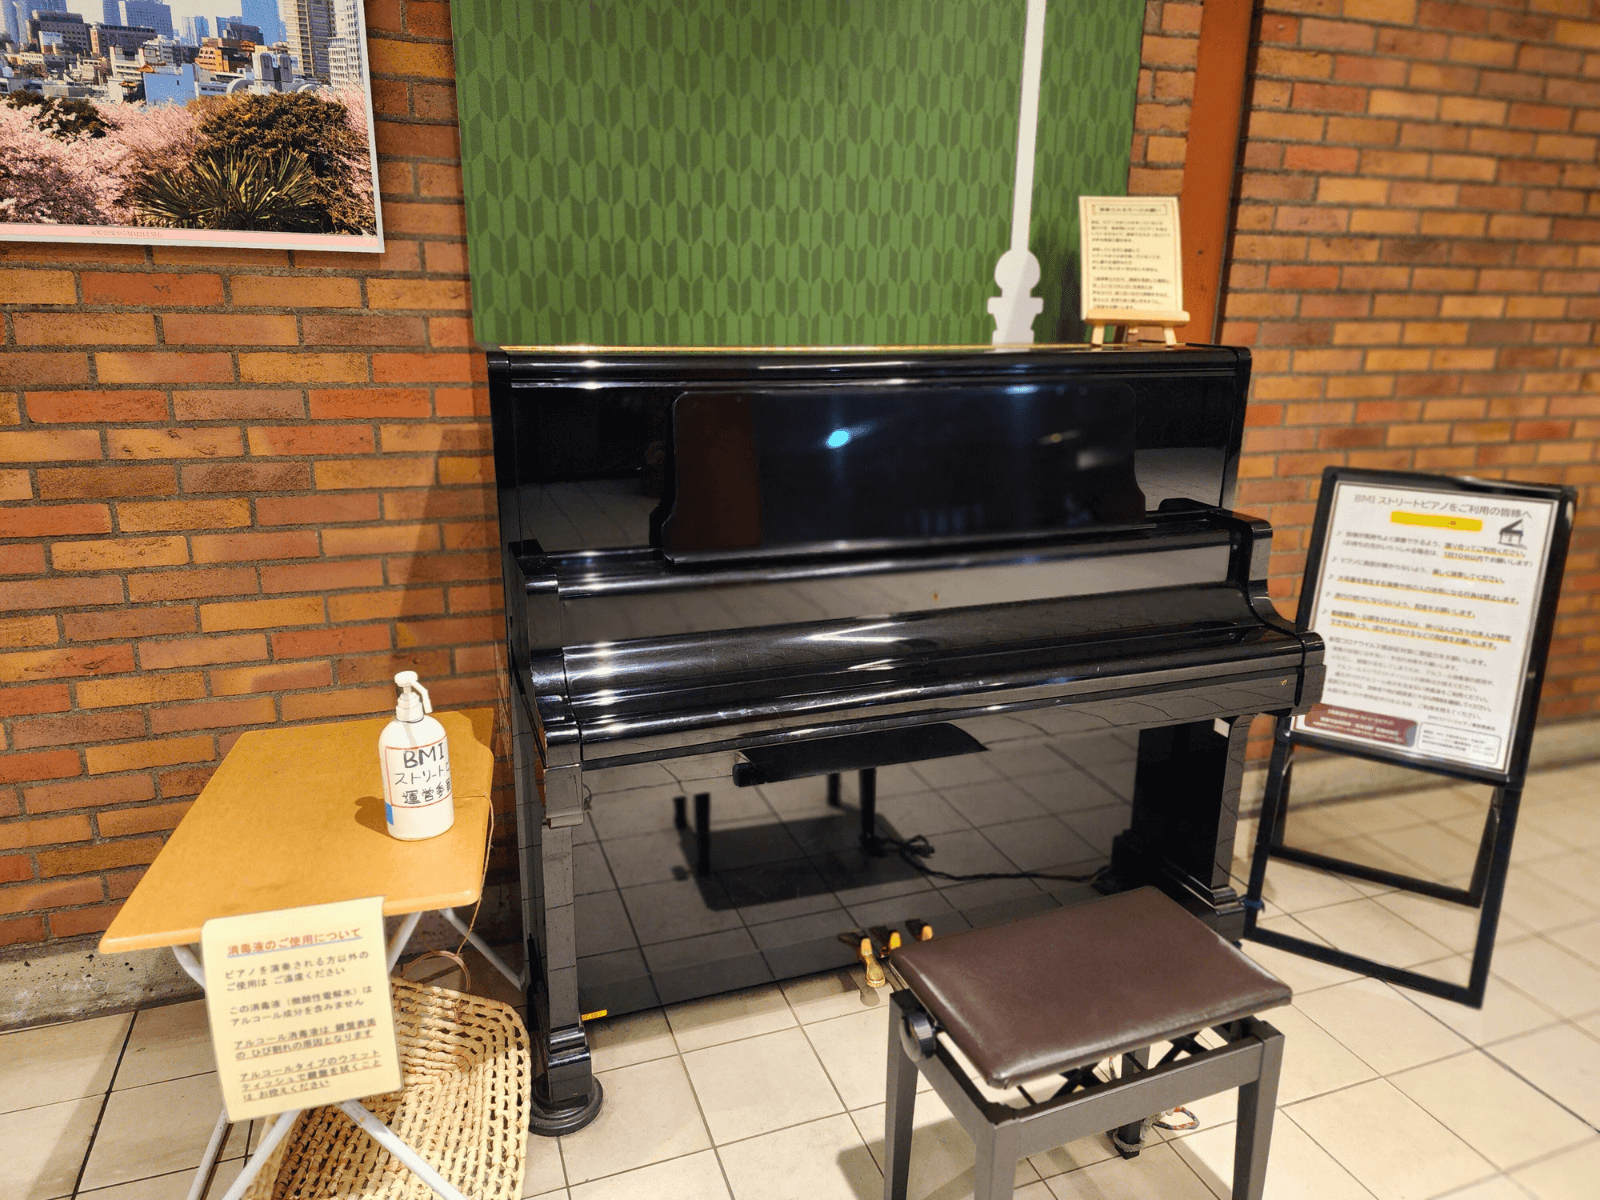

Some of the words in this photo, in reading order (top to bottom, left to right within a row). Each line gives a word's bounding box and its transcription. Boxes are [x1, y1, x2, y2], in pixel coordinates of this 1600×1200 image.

[1354, 494, 1376, 505] BMI
[1378, 496, 1532, 519] ストリートピアノをご利用の皆様へ
[403, 742, 445, 769] BMI
[228, 928, 361, 956] 消毒液のご使用について
[225, 951, 369, 980] ピアノを演奏される方以外の
[231, 998, 364, 1026] アルコール成分を含みません
